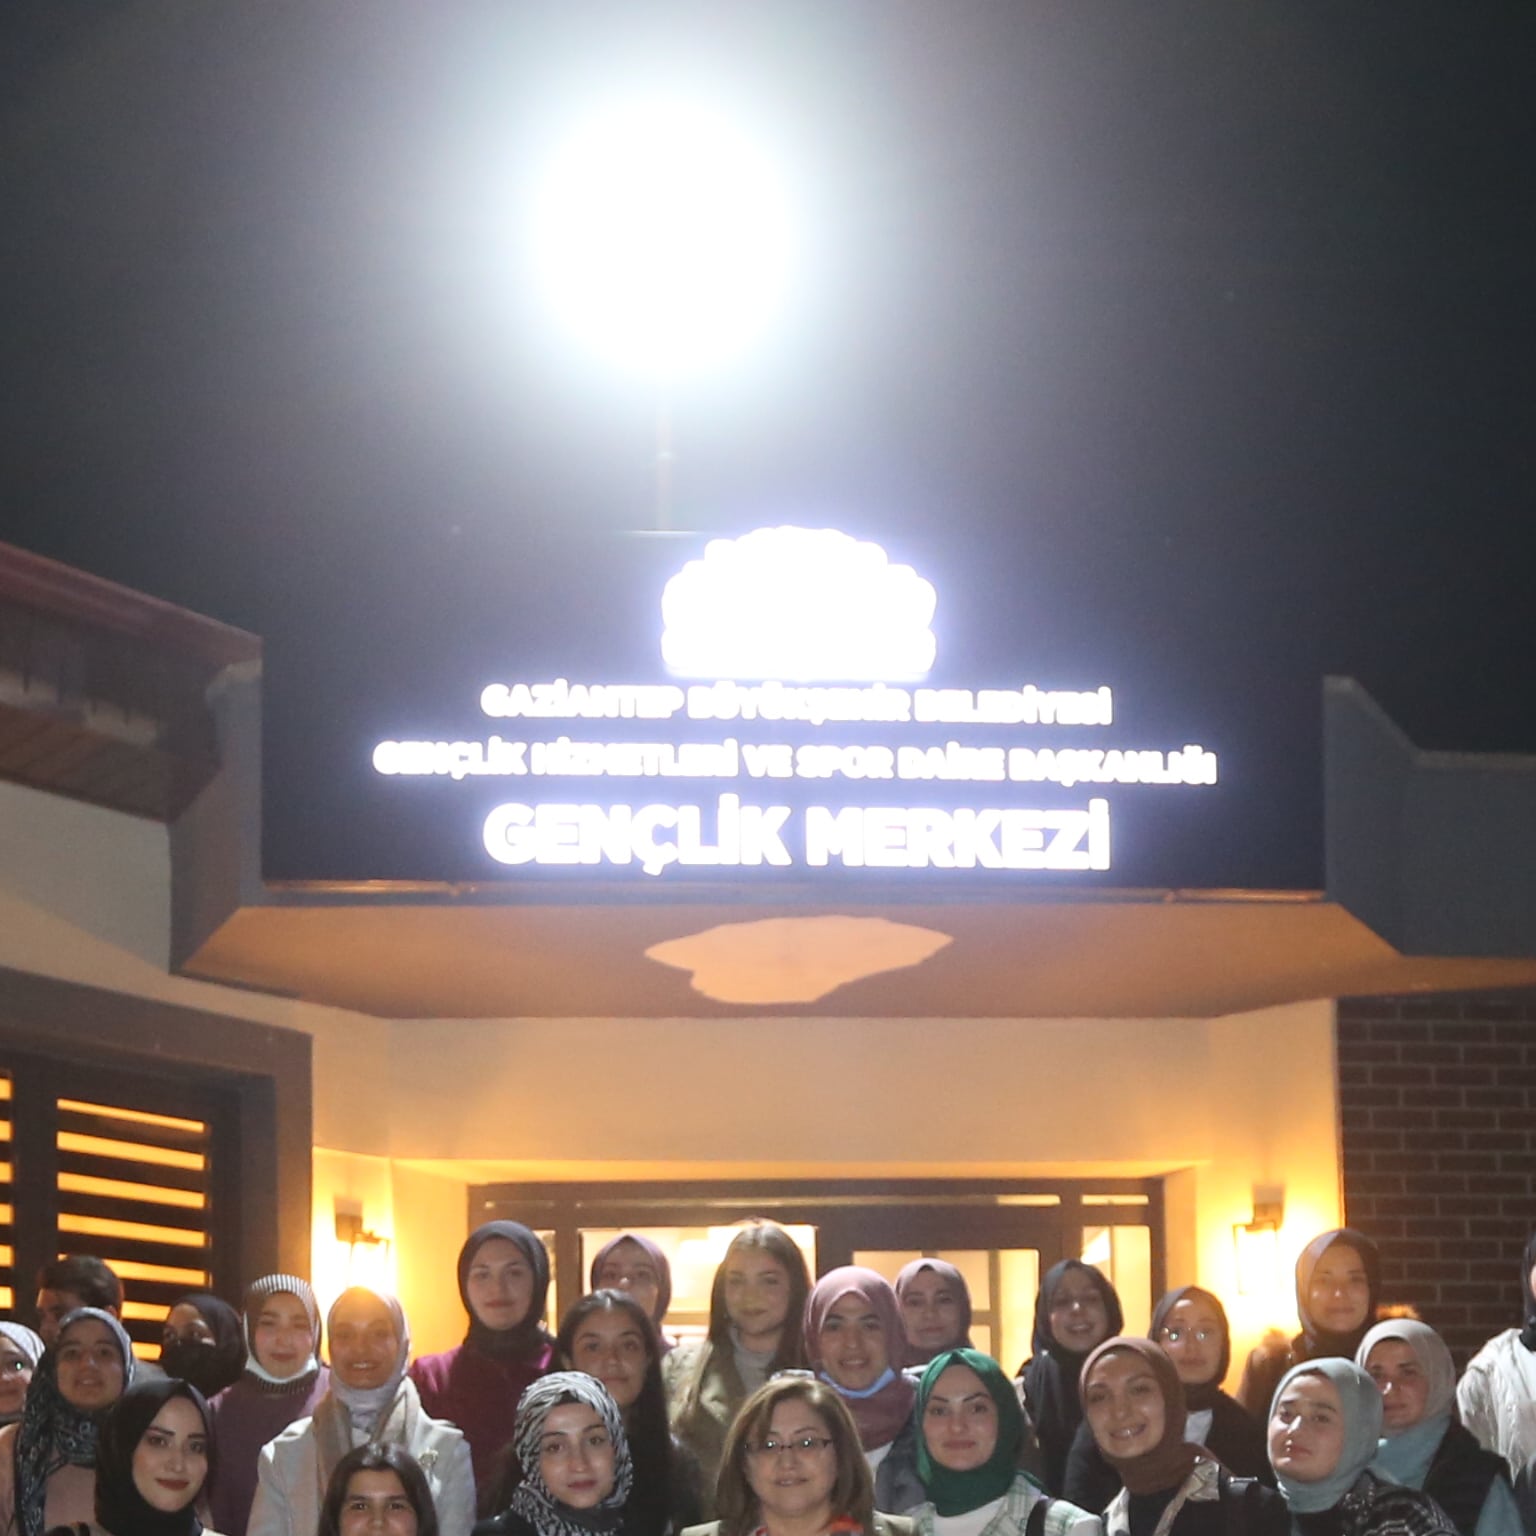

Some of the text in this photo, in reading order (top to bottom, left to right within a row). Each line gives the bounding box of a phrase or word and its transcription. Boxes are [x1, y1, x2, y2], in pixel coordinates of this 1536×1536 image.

[481, 678, 685, 718] GAZİANTEP
[914, 684, 1112, 725] BELEDİYESİ
[373, 736, 527, 780] GENÇLİK
[741, 744, 793, 777] VE
[795, 745, 894, 779] SPOR
[898, 740, 1005, 780] DAİRE
[483, 793, 1110, 876] GENÇLİK MERKEZİ
